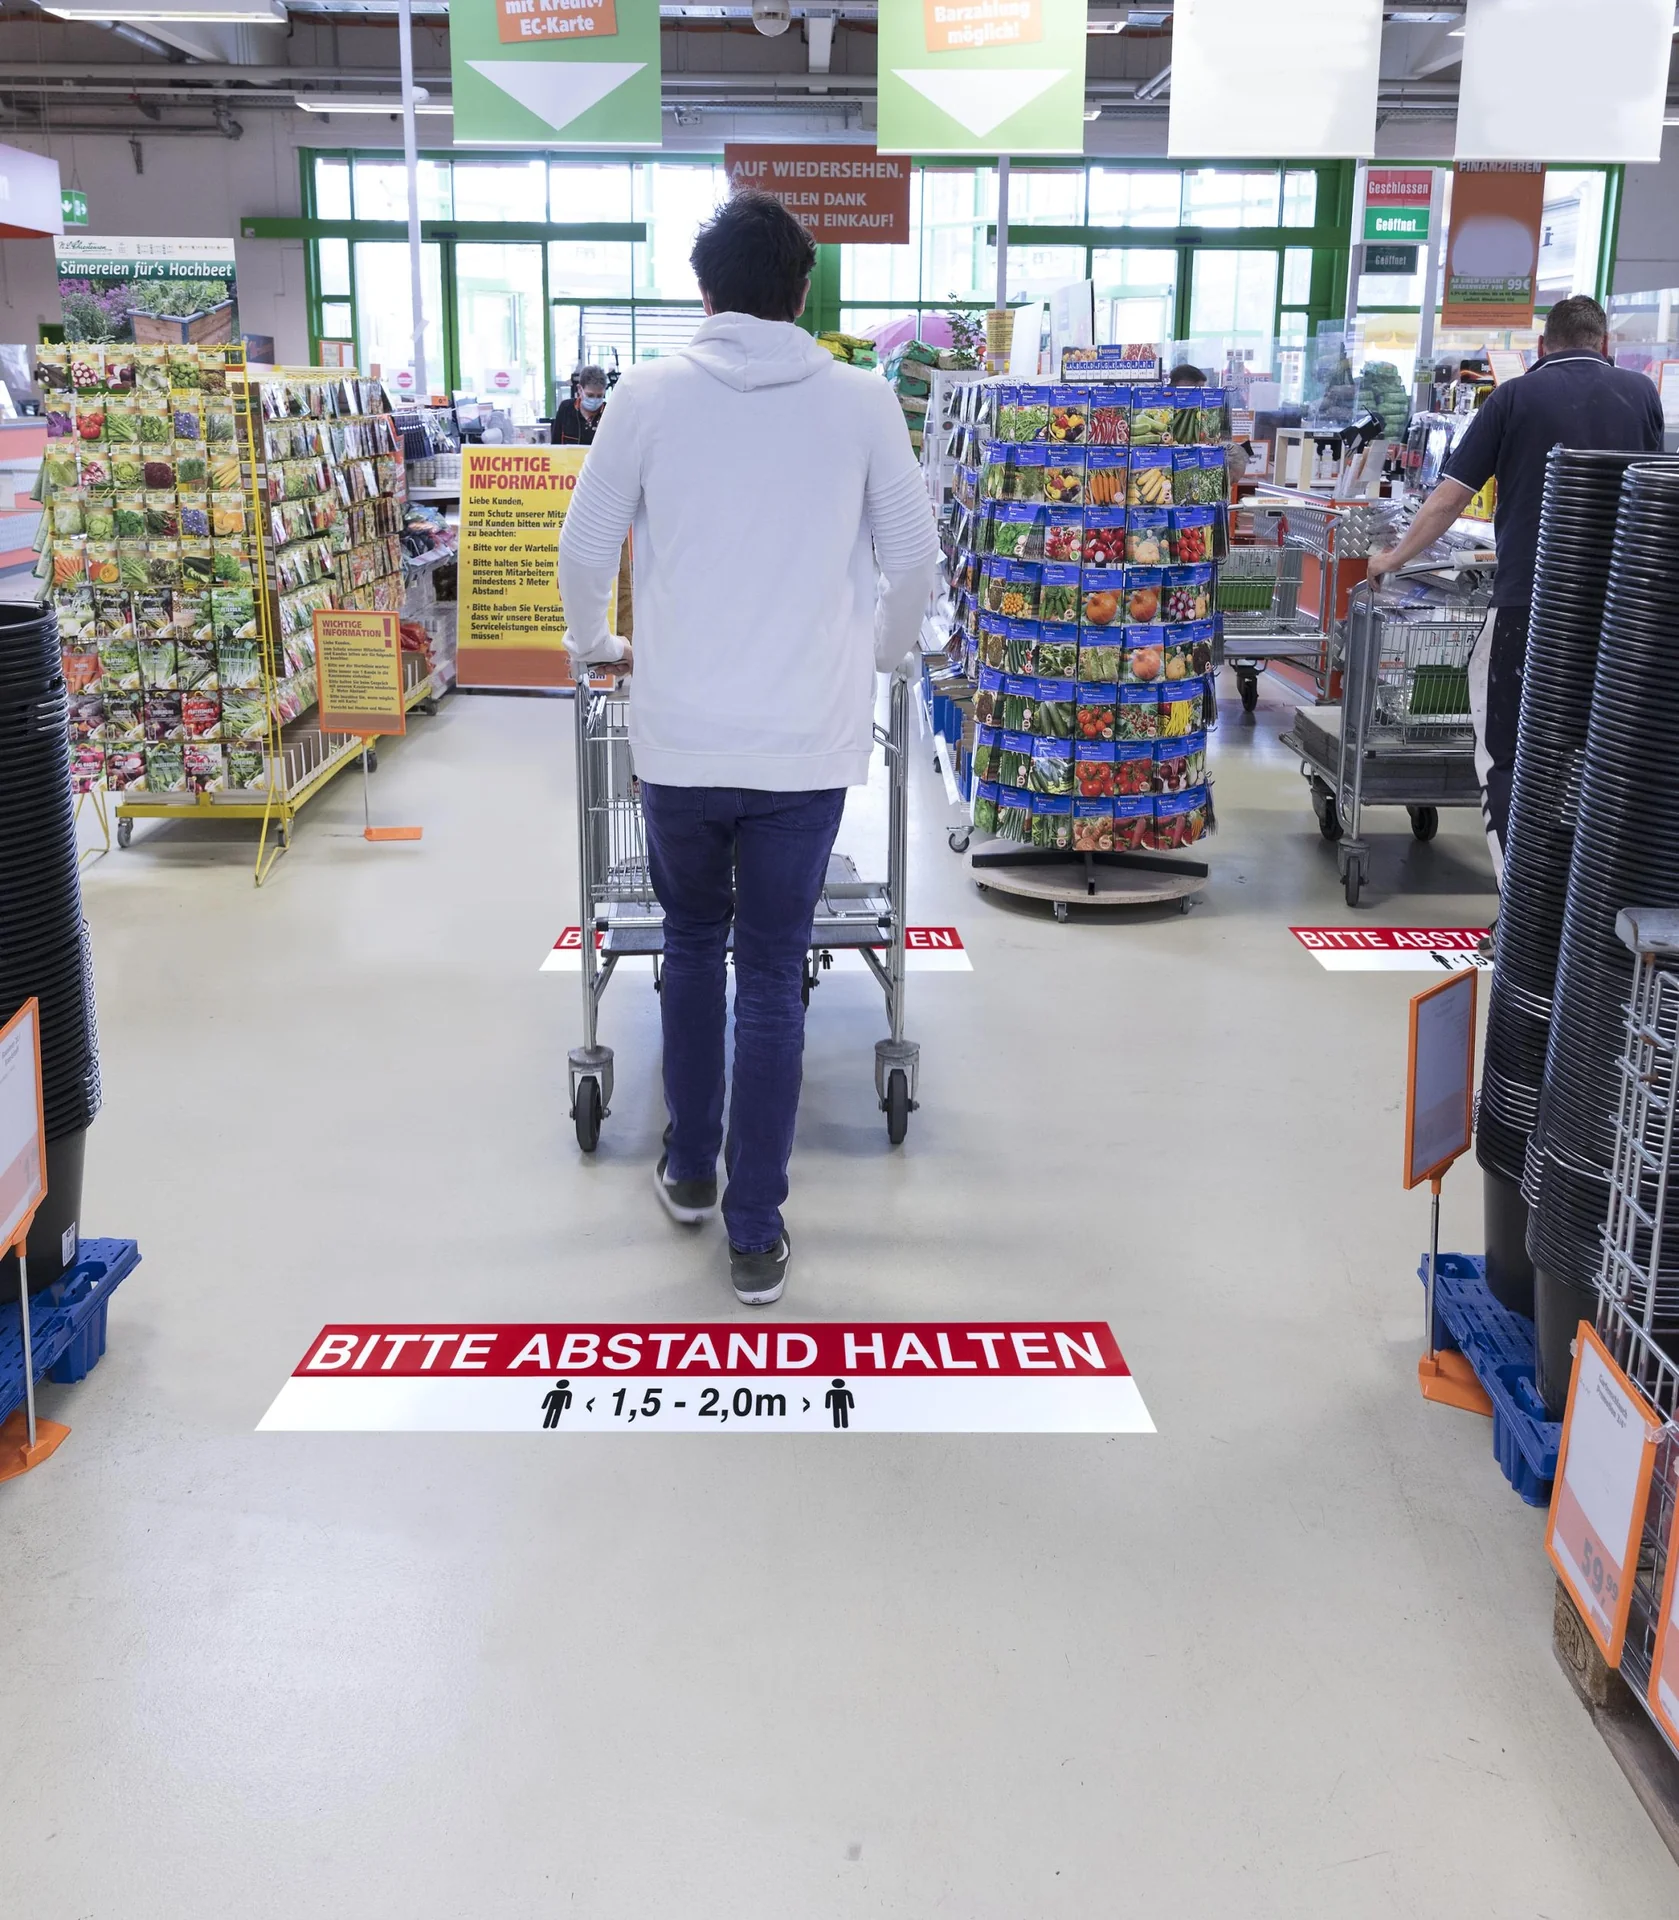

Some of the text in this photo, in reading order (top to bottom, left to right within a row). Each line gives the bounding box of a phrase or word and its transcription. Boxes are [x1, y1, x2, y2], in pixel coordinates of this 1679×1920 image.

[505, 0, 535, 14] mit
[934, 0, 1030, 23] Barzahlung
[520, 14, 595, 36] EC-Karte
[947, 21, 1019, 46] möglich!
[732, 161, 904, 178] AUF WIEDERSEHEN.
[1459, 161, 1542, 173] FINANZIEREN
[1369, 181, 1429, 195] Geschlossen
[824, 193, 867, 206] DANK
[824, 214, 894, 227] EINKAUF!
[1376, 217, 1417, 232] Geöffnet
[1375, 254, 1407, 265] Geöffnet
[61, 260, 129, 275] Sämereien
[169, 262, 232, 277] Hochbeet
[470, 456, 551, 472] WICHTIGE
[470, 474, 579, 490] INFORMATIO
[492, 497, 524, 506] Kunden,
[487, 510, 513, 518] Schutz
[468, 519, 565, 528] und Kunden bitten wir S
[479, 529, 517, 537] beachten:
[473, 543, 492, 551] Bitte
[509, 544, 522, 552] der
[472, 559, 554, 567] Bitte halten Sie beim
[505, 568, 554, 577] Mitarbeitern
[472, 577, 517, 585] mindestens
[526, 578, 550, 586] Meter
[472, 603, 491, 611] Bitte
[533, 604, 564, 612] Verstän
[471, 612, 489, 621] dass
[491, 613, 504, 621] wir
[534, 614, 565, 622] Beratun
[322, 620, 362, 629] WICHTIGE
[471, 622, 539, 633] Serviceleistungen
[323, 629, 382, 637] INFORMATION
[1297, 931, 1490, 948] BITTE ABSTA
[305, 1332, 1107, 1371] BITTE ABSTAND HALTEN
[611, 1387, 663, 1423] 1,5
[697, 1387, 787, 1422] 2,0m
